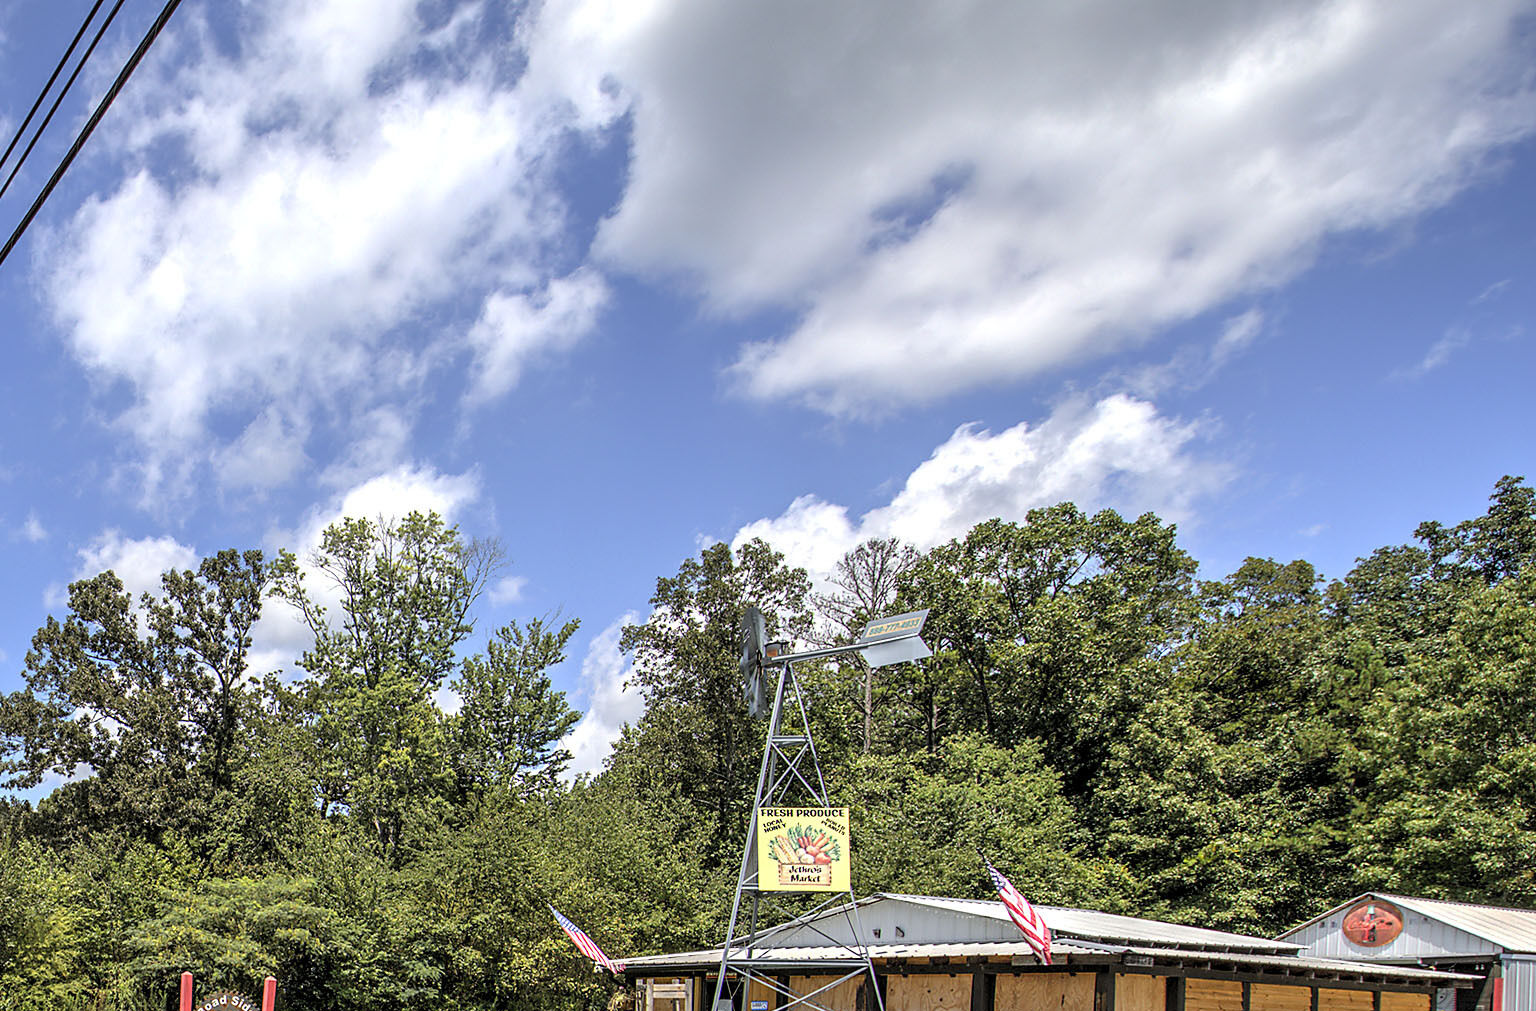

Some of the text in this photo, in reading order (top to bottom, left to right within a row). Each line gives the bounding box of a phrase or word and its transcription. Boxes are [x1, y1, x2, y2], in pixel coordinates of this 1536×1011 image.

[760, 809, 845, 817] FRESH PRODUCE
[763, 818, 783, 828] LOCAL
[790, 874, 821, 882] Market
